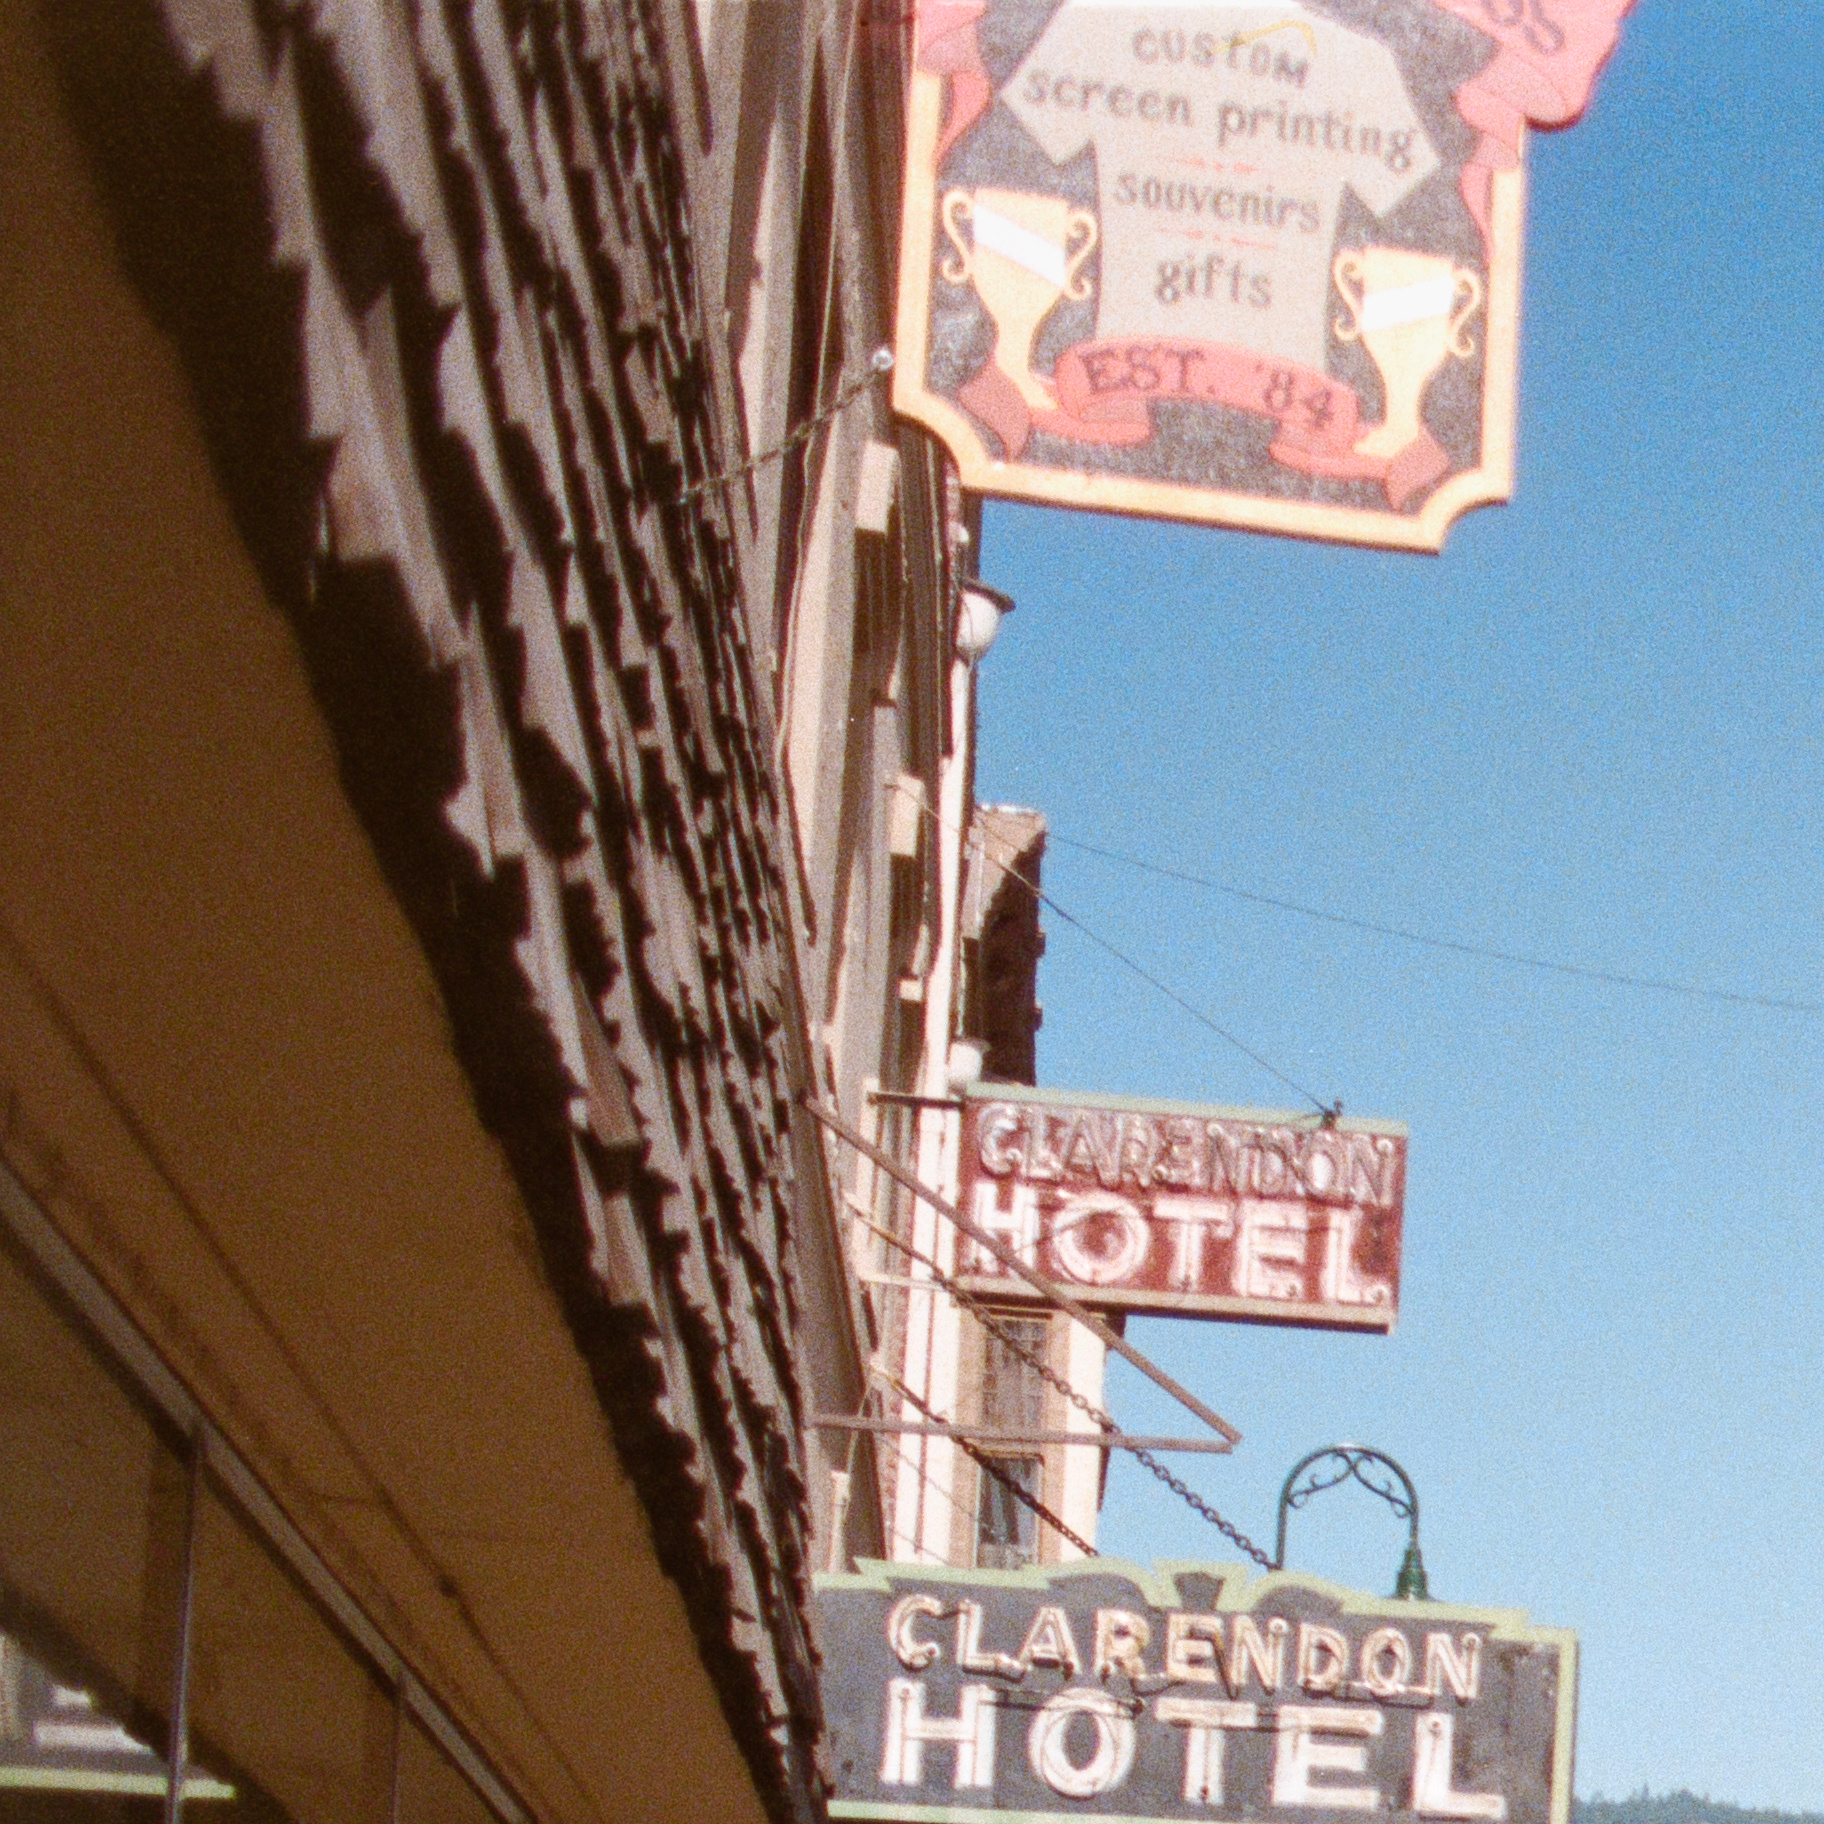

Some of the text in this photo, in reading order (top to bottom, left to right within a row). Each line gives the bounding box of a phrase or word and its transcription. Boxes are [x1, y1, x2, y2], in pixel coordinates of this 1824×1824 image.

[1023, 68, 1417, 174] screen printing
[1115, 171, 1321, 234] souvenirs
[1154, 251, 1274, 310] gifts
[977, 1102, 1396, 1207] CLARENDON
[965, 1182, 1392, 1306] HOTEL
[887, 1593, 1483, 1699] CLARENDON
[880, 1678, 1506, 1820] HOTEL
